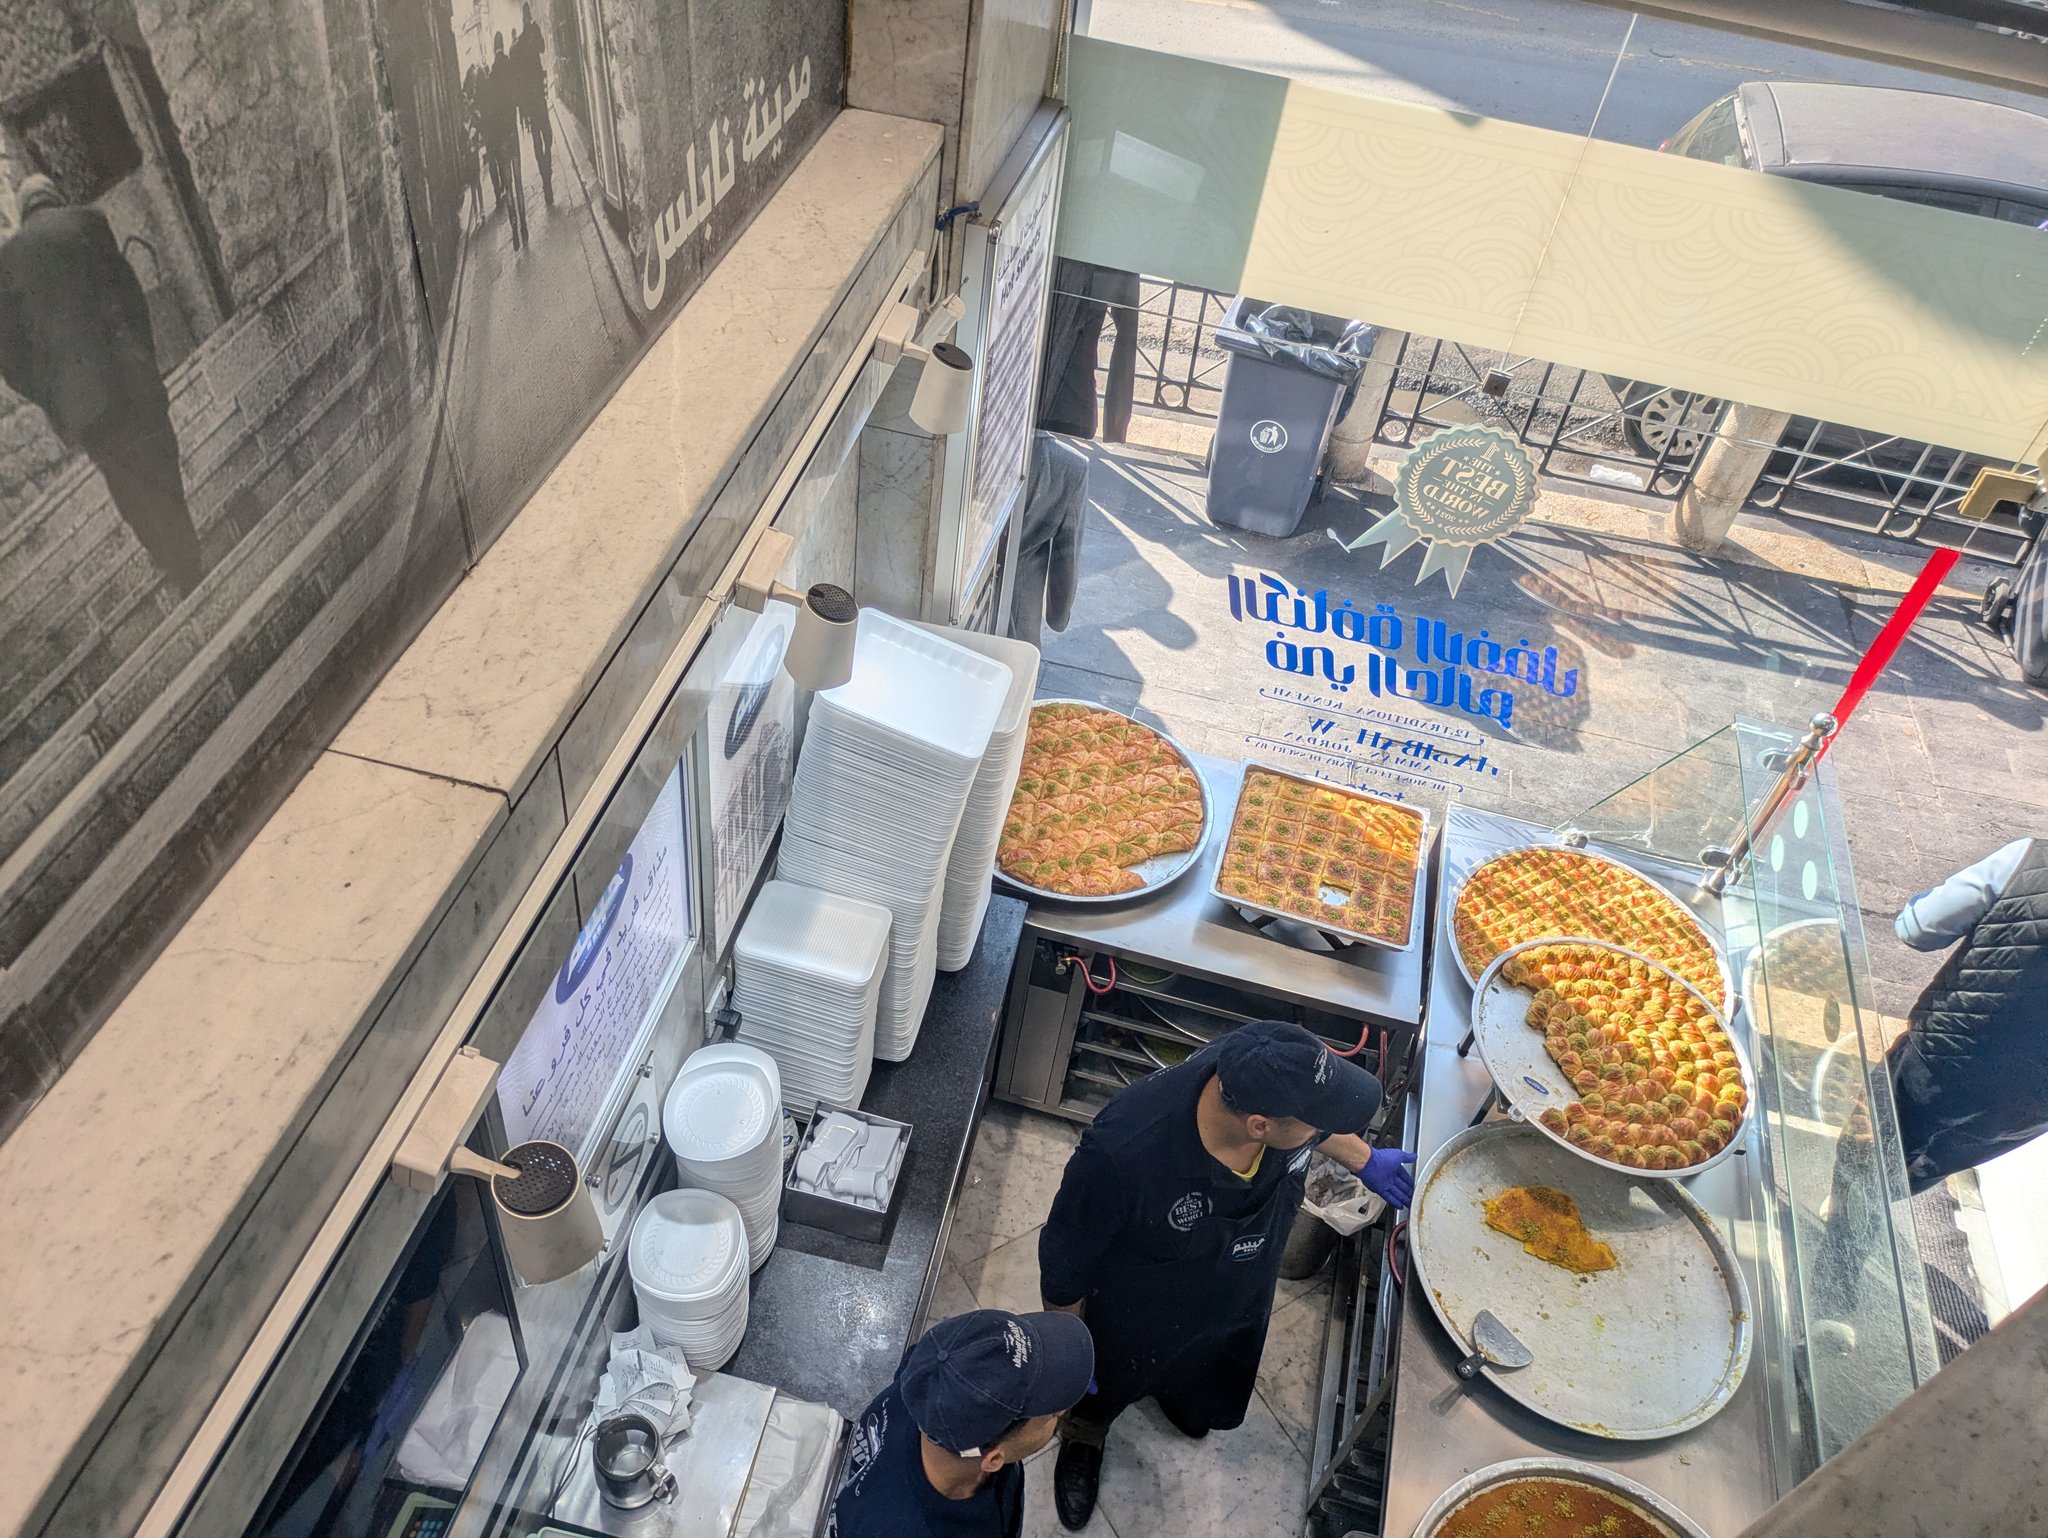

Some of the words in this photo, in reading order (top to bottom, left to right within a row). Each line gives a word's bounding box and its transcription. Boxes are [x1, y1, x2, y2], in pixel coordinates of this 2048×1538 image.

[743, 55, 811, 162] مدينة
[643, 115, 736, 310] نابلس
[643, 847, 666, 901] مذاق
[616, 895, 638, 946] فريد
[596, 947, 611, 990] في
[576, 987, 590, 1027] كل
[522, 1025, 570, 1115] فروعنا
[1175, 1200, 1203, 1216] BEST
